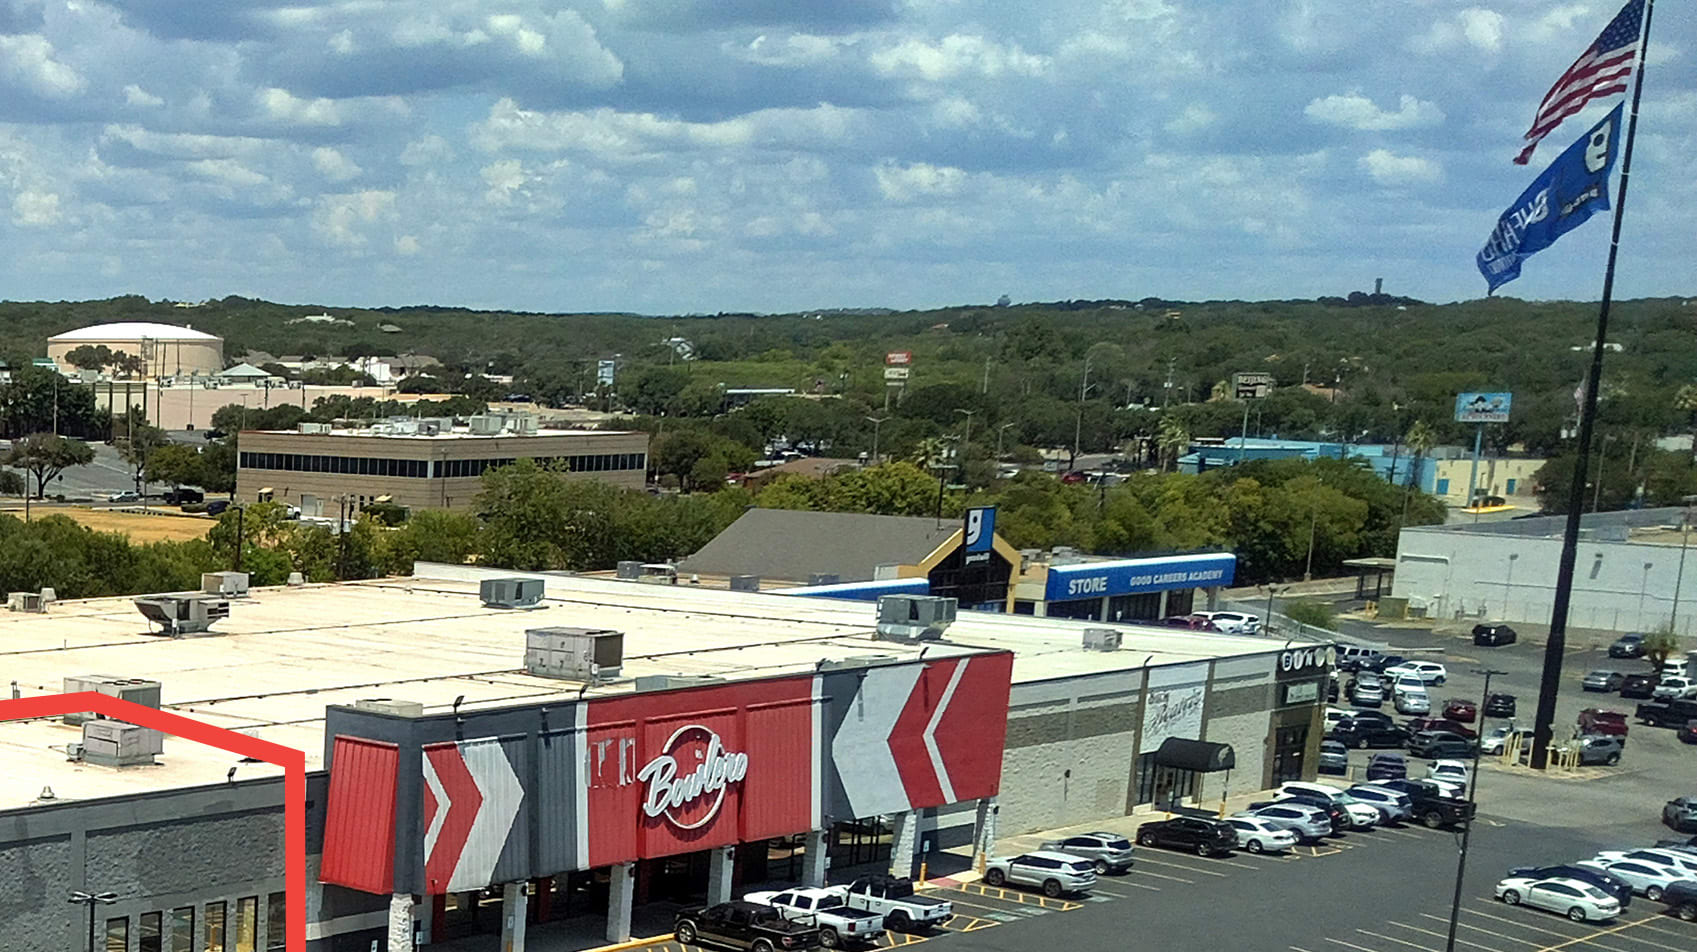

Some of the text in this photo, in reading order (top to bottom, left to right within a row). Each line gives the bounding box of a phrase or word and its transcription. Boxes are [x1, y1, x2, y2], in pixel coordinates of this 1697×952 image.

[1068, 576, 1108, 595] STORE
[1130, 569, 1223, 587] GOOD CAREERS ACADEMY
[637, 733, 748, 817] Bowlero
